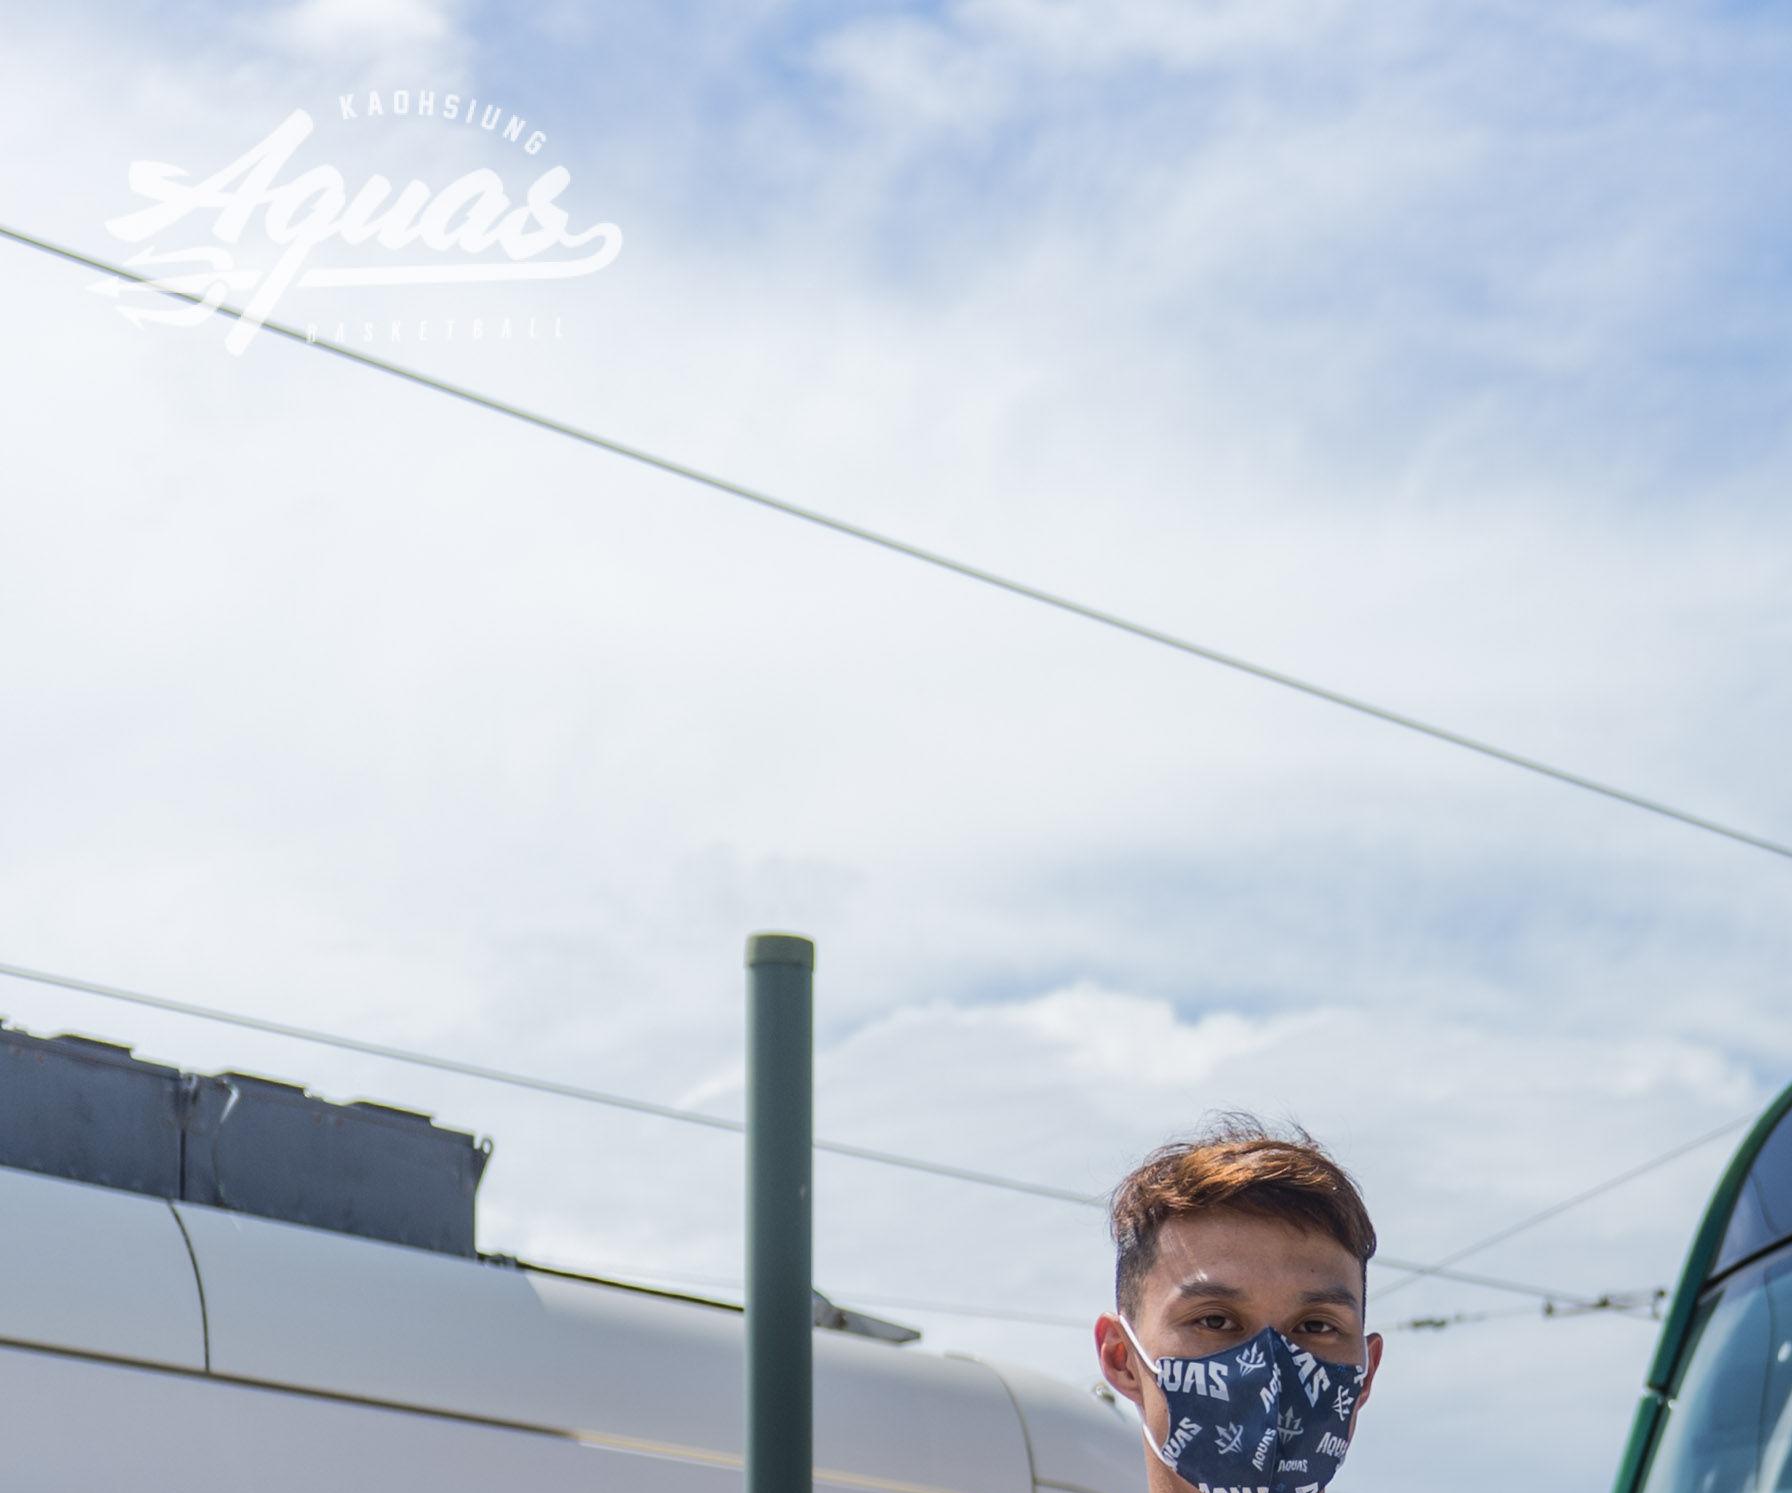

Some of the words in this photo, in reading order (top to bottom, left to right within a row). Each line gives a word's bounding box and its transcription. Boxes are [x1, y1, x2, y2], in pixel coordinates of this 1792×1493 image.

[1157, 1359, 1230, 1402] UAS
[1252, 1428, 1277, 1472] AQUAS
[1278, 1459, 1308, 1473] AQUAS
